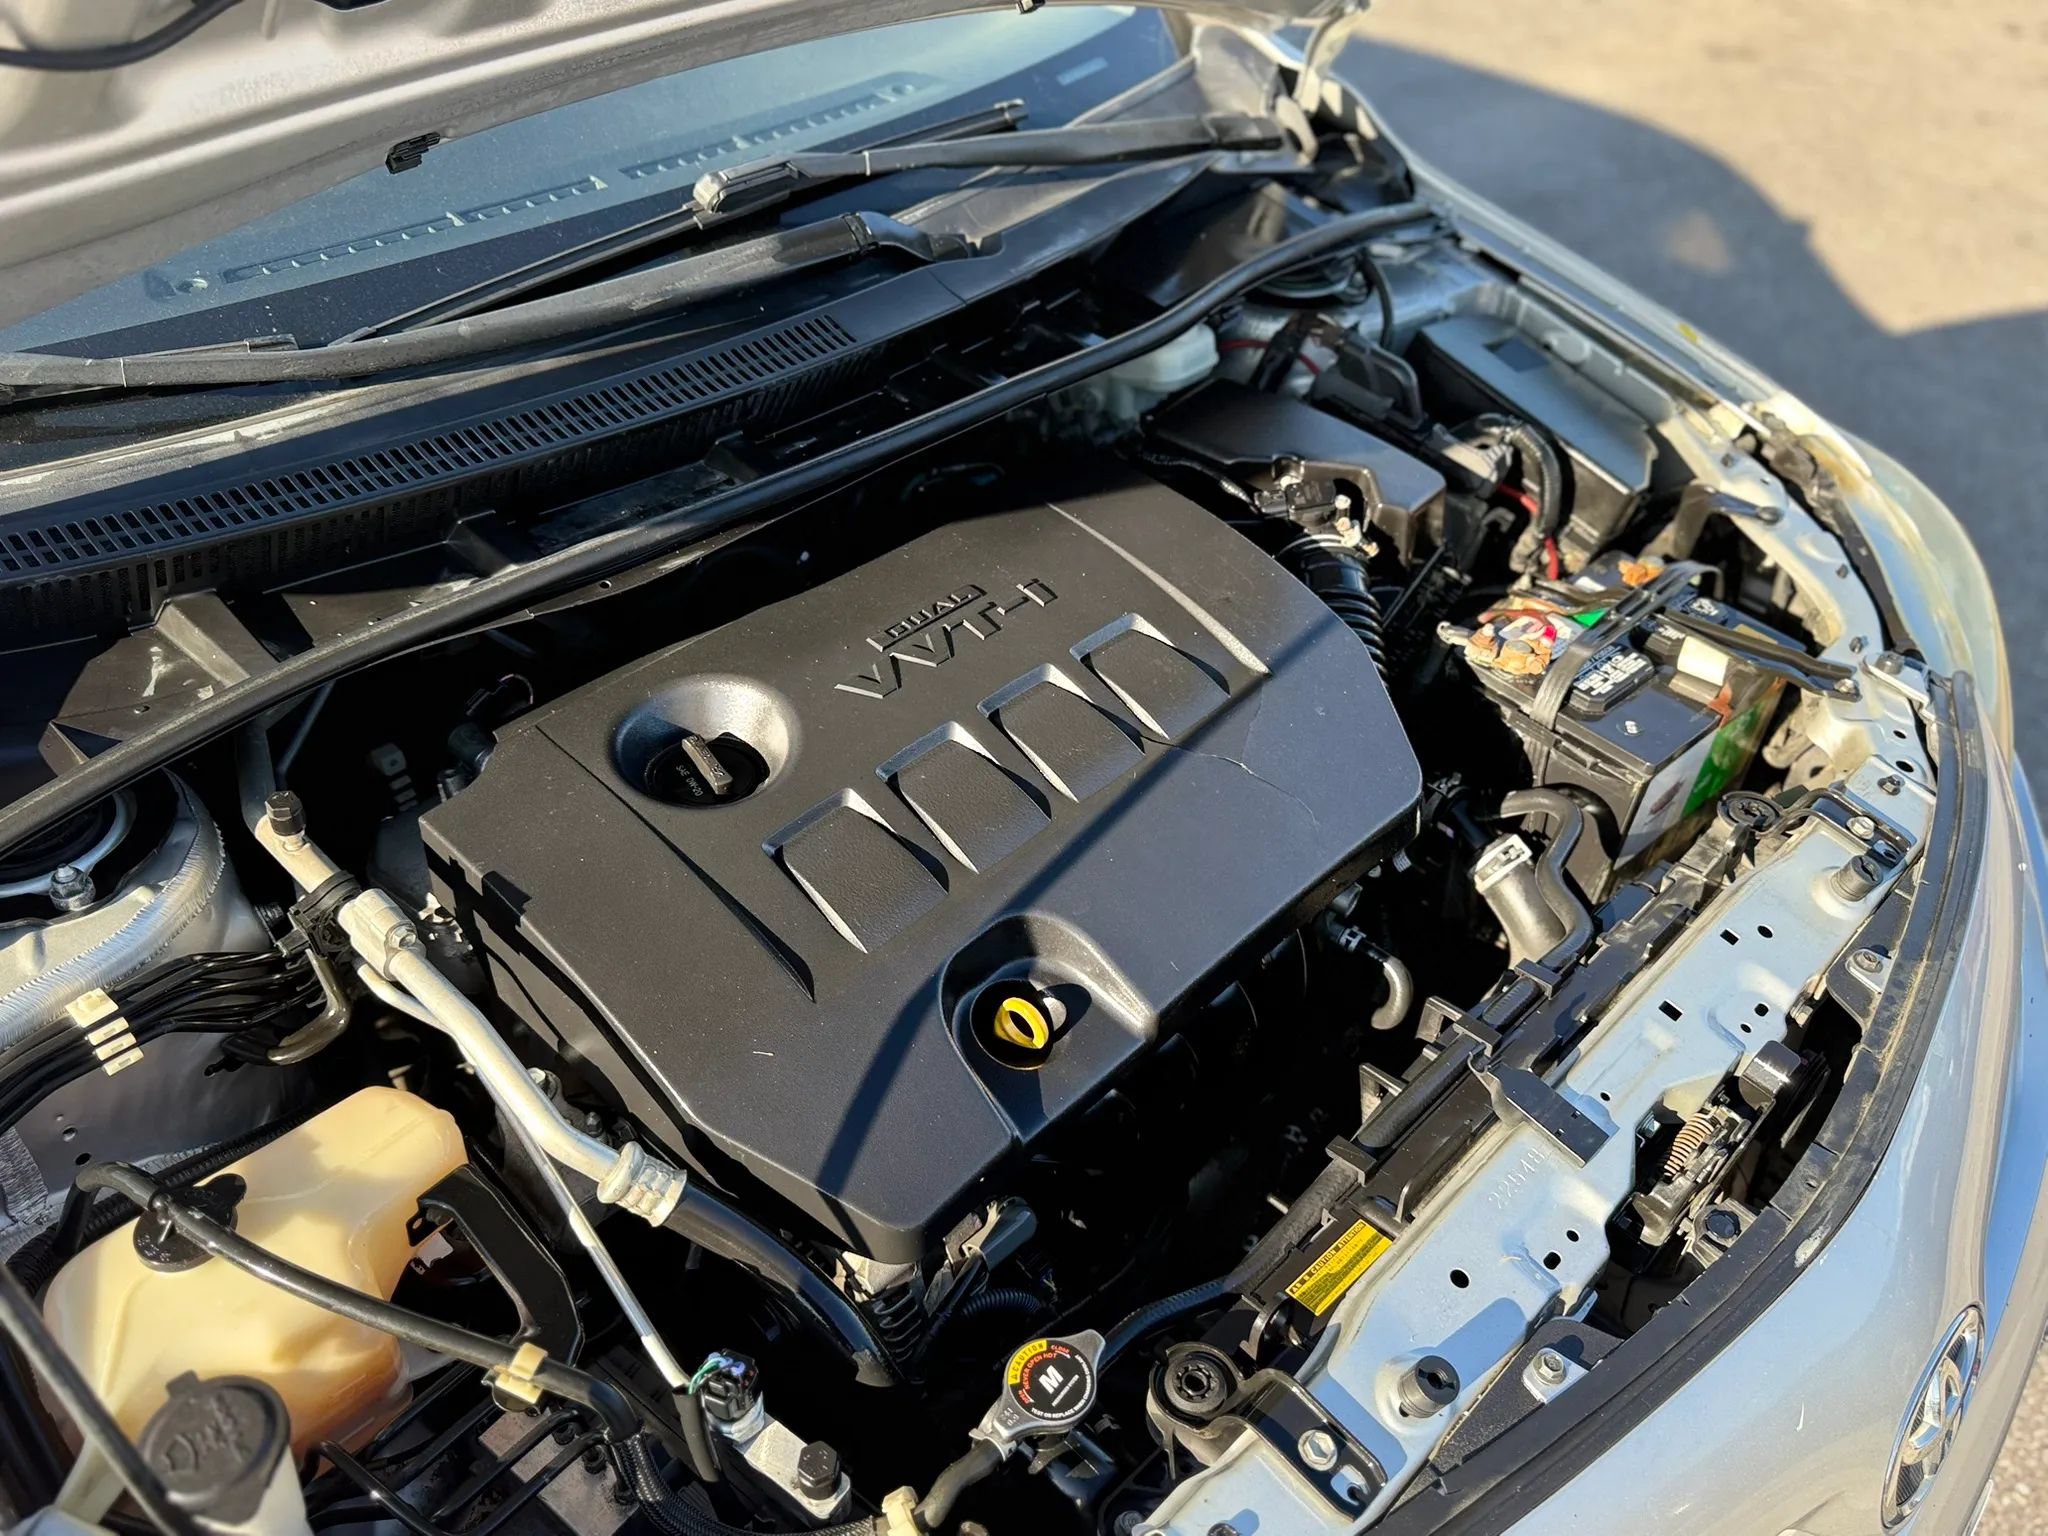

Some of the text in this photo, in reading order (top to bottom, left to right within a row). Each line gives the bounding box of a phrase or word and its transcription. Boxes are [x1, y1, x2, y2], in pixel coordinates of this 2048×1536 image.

[884, 593, 972, 638] DUAL
[1311, 1223, 1366, 1274] CAUTION ATTENTION
[1013, 1343, 1044, 1371] CAUTION
[1022, 1366, 1030, 1389] NEVER
[1026, 1354, 1043, 1368] OPEN
